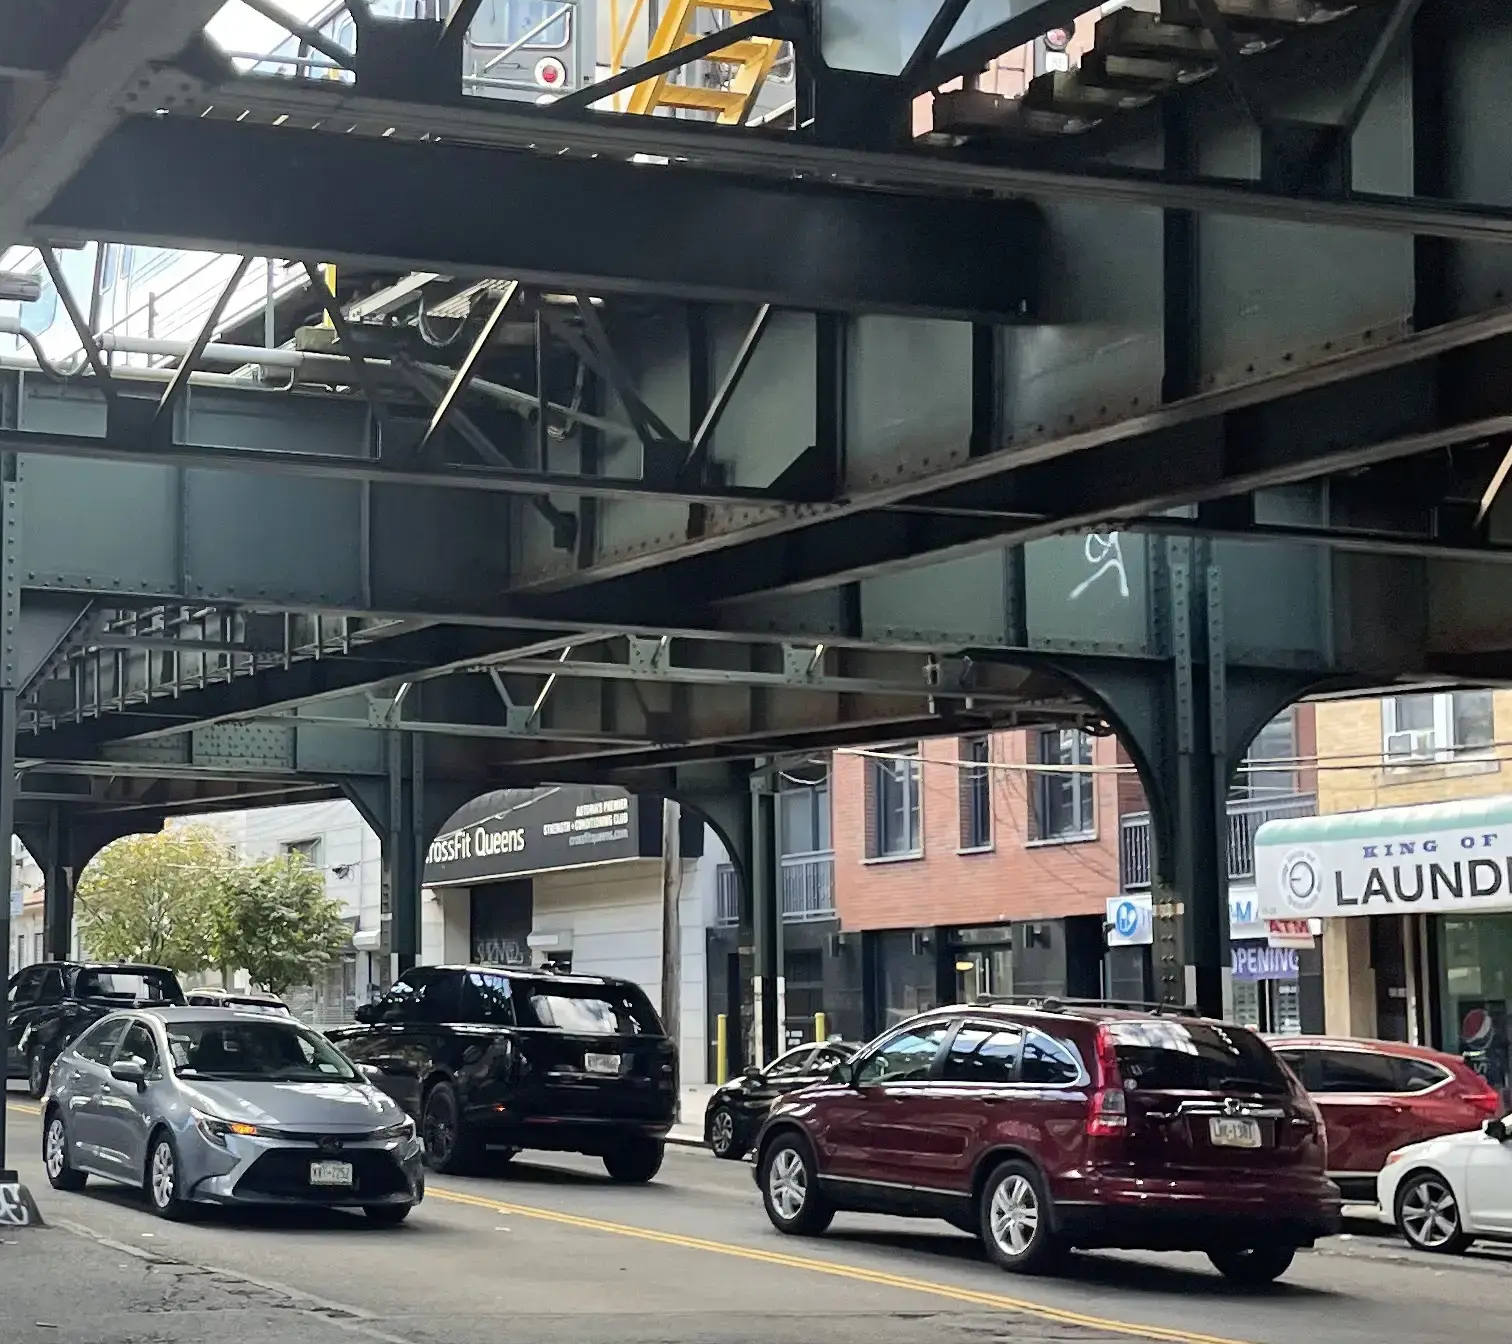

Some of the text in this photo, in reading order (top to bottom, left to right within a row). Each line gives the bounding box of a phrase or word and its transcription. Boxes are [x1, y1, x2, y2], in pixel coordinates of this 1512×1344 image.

[475, 827, 525, 857] Queens
[1363, 834, 1498, 858] KING OF
[1335, 858, 1512, 906] LAUND
[1270, 919, 1310, 935] ATM
